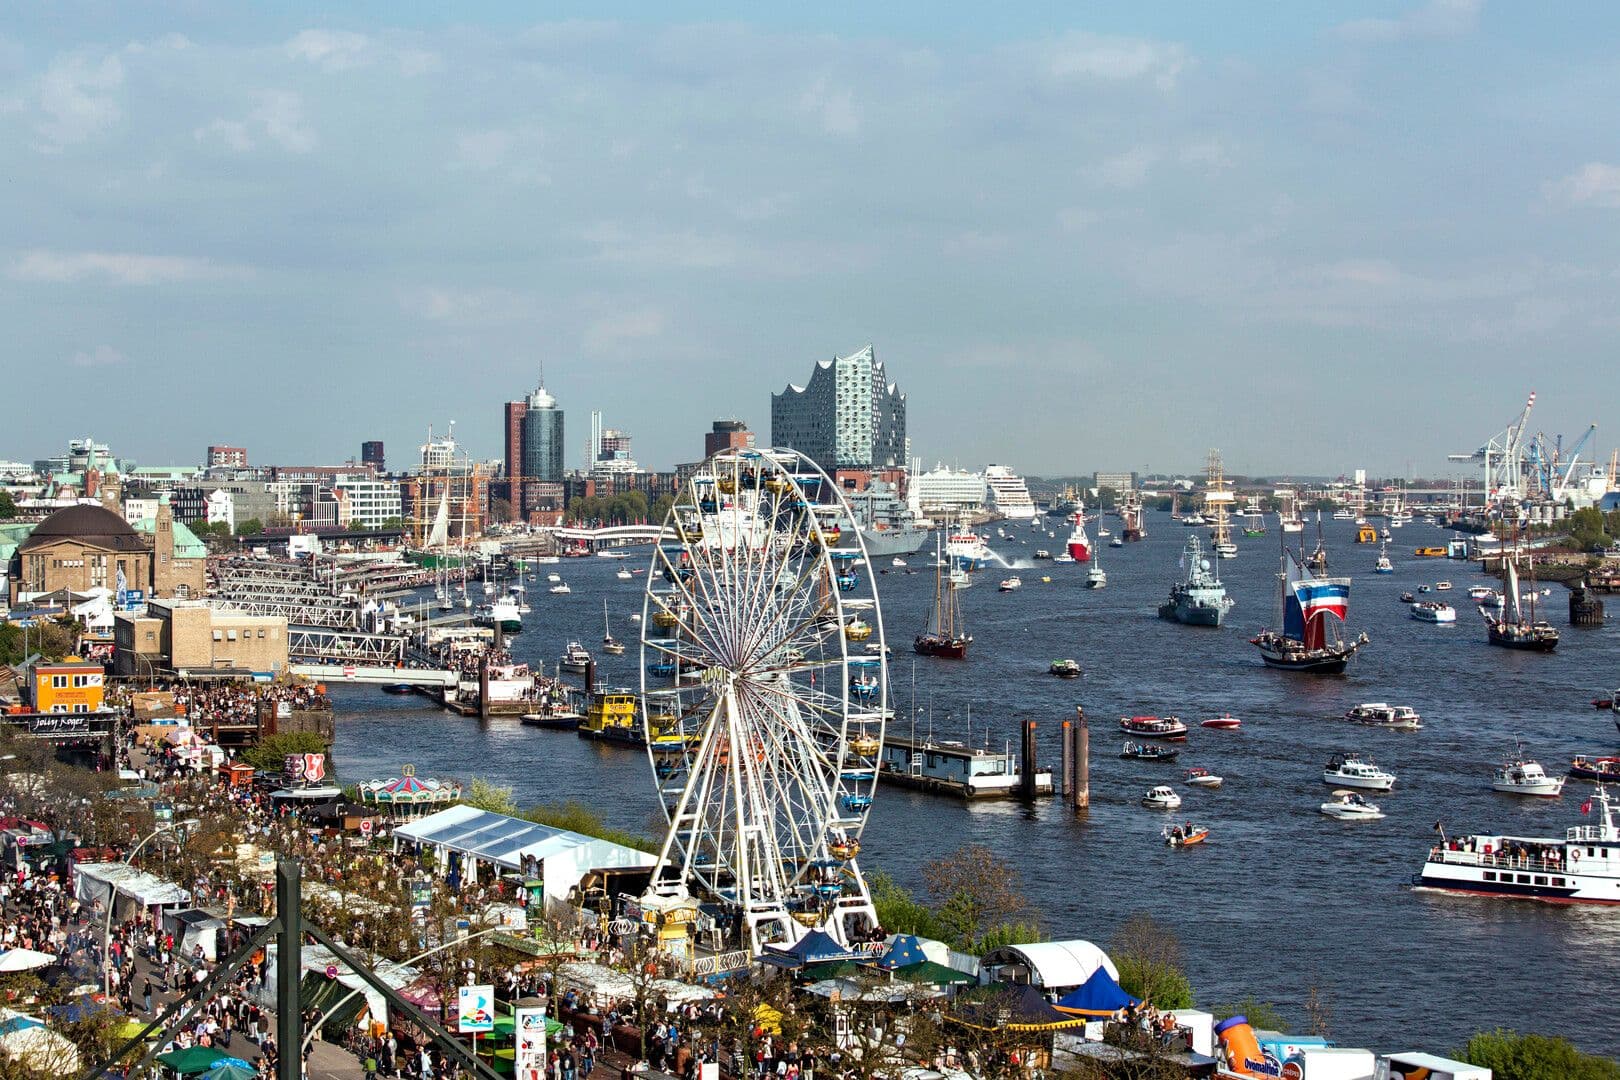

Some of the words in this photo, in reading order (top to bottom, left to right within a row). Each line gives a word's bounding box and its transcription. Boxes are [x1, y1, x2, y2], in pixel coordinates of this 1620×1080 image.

[33, 717, 59, 731] Jolly
[60, 717, 85, 731] Roger
[1245, 1058, 1279, 1077] Ovomaltine
